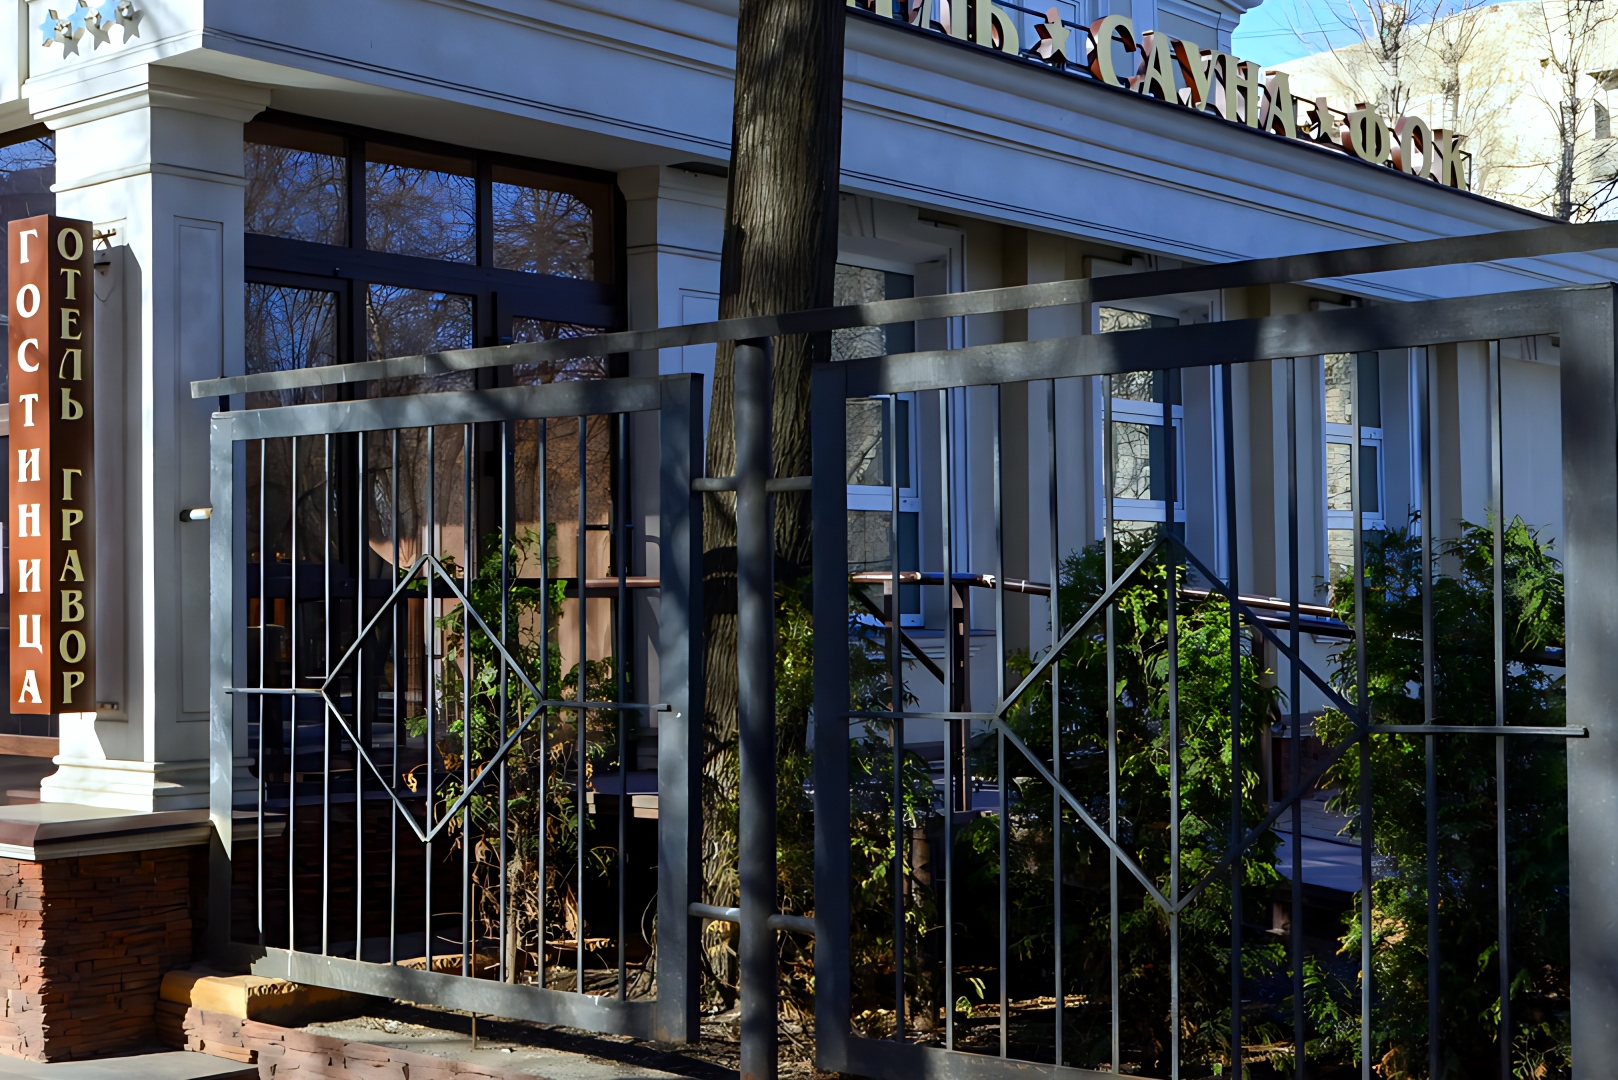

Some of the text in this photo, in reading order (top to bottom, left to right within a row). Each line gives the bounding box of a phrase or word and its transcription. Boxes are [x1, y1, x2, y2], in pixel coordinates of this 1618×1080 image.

[1093, 14, 1298, 139] САУНА
[1345, 102, 1469, 191] ФОК
[15, 228, 44, 704] ГОСТИНИЦА
[56, 227, 87, 705] ОТЕЛЬ ГРАВОР
